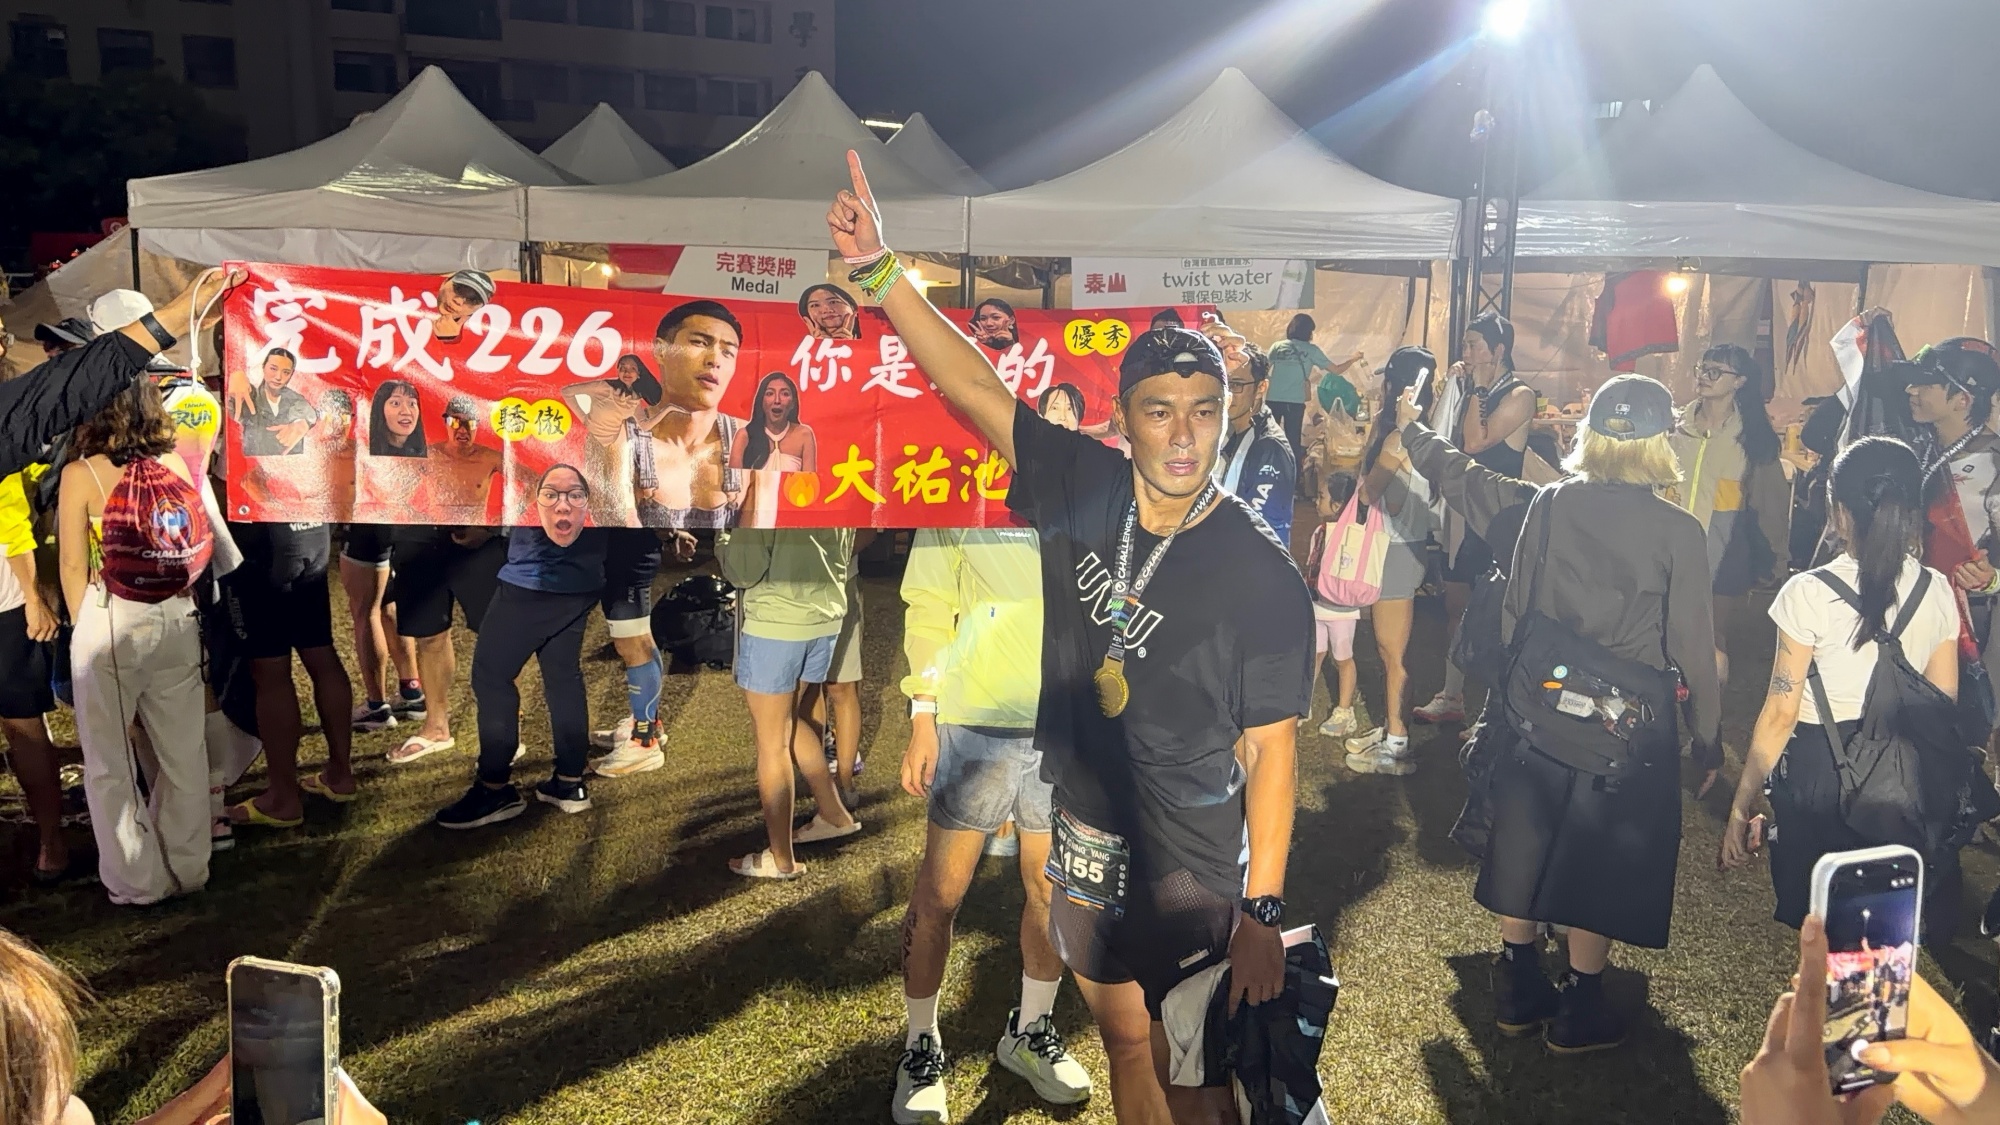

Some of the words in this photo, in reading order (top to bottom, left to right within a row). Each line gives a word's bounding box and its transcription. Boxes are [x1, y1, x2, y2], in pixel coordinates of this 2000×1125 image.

[716, 252, 797, 279] 完賽獎牌
[731, 276, 779, 295] Medal
[1084, 272, 1127, 294] 泰山
[1162, 271, 1211, 288] twist
[1217, 269, 1273, 286] water
[1181, 288, 1253, 305] 環保包裝水
[248, 279, 622, 381] 完成226
[1071, 325, 1128, 350] 優秀
[790, 334, 1056, 400] 你是的
[497, 405, 565, 436] 驕傲
[1117, 513, 1135, 579] CHALLENGE
[1090, 847, 1110, 862] YANG
